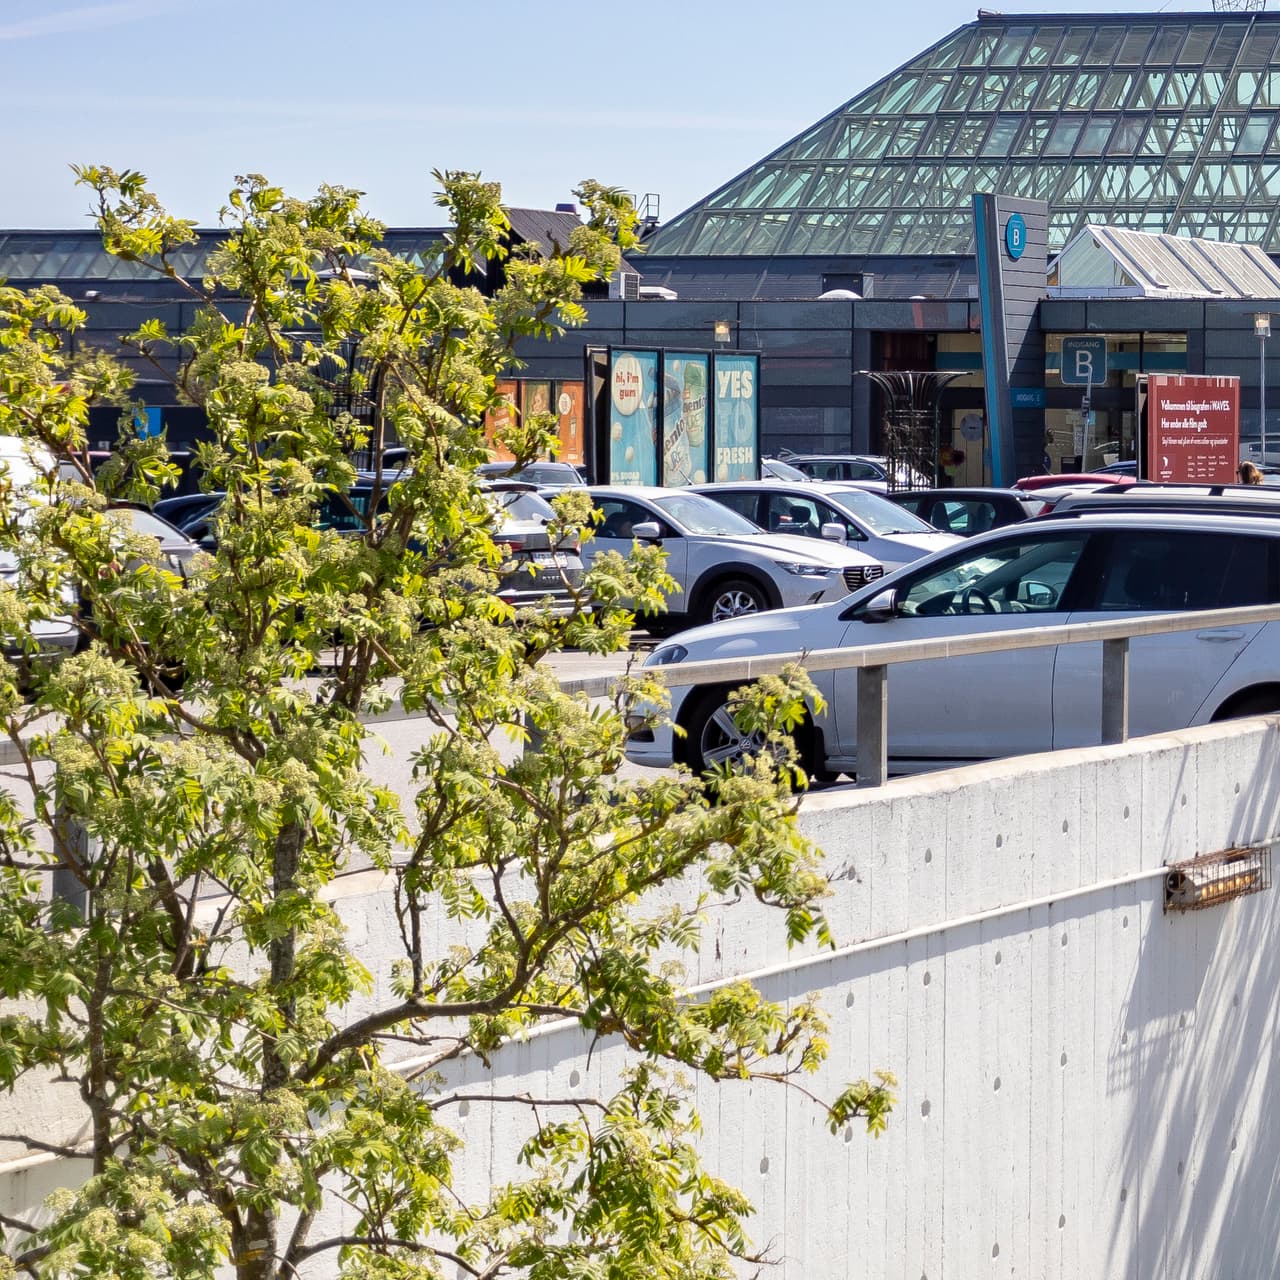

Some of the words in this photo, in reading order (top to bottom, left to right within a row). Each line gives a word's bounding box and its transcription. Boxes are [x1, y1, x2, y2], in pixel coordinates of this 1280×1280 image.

[1013, 228, 1020, 246] B
[1076, 350, 1093, 377] B
[717, 370, 753, 399] YES
[619, 388, 636, 400] gum
[717, 447, 753, 465] FRESH
